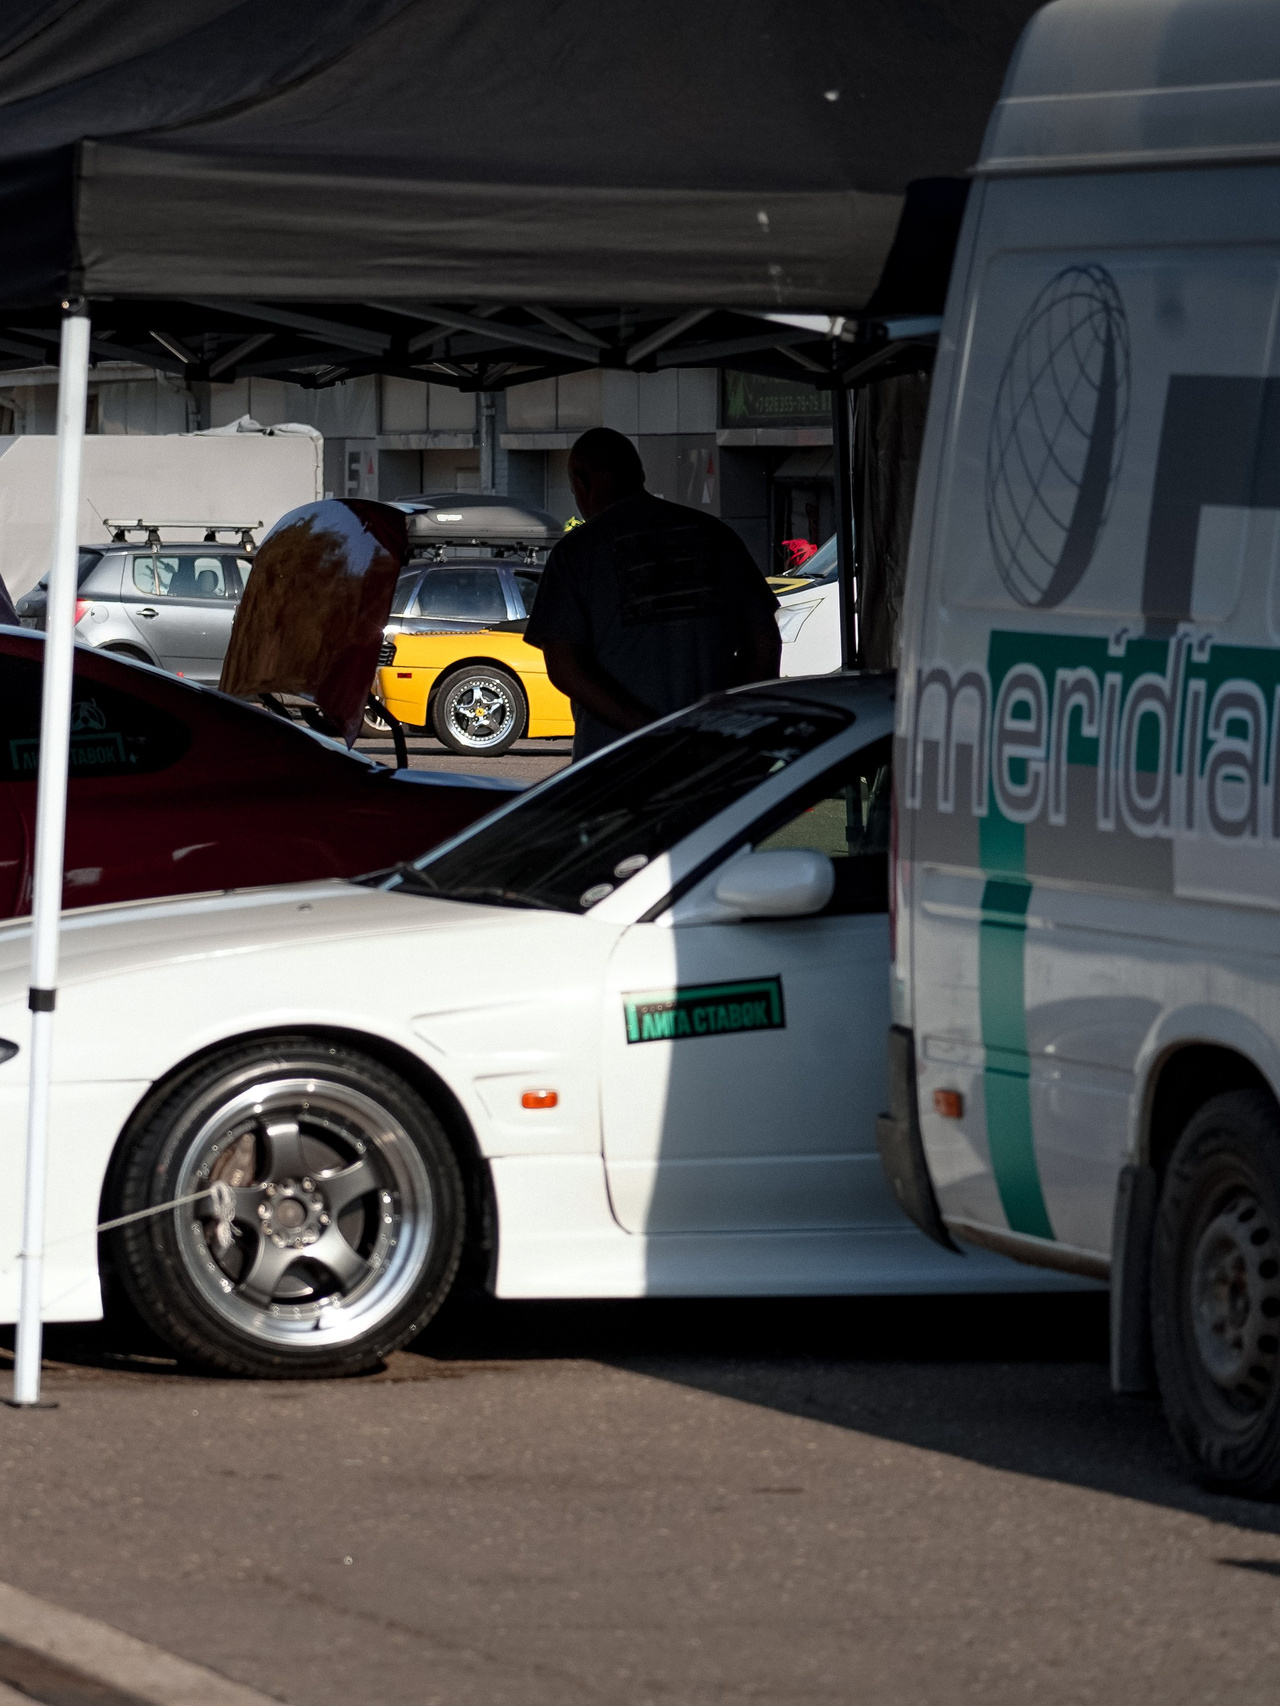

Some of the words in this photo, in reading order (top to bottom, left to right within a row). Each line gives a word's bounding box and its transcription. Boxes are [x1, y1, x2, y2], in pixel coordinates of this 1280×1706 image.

[904, 622, 1280, 849] meridia
[70, 745, 117, 766] ТАВОК
[692, 1001, 768, 1034] СТАВОК
